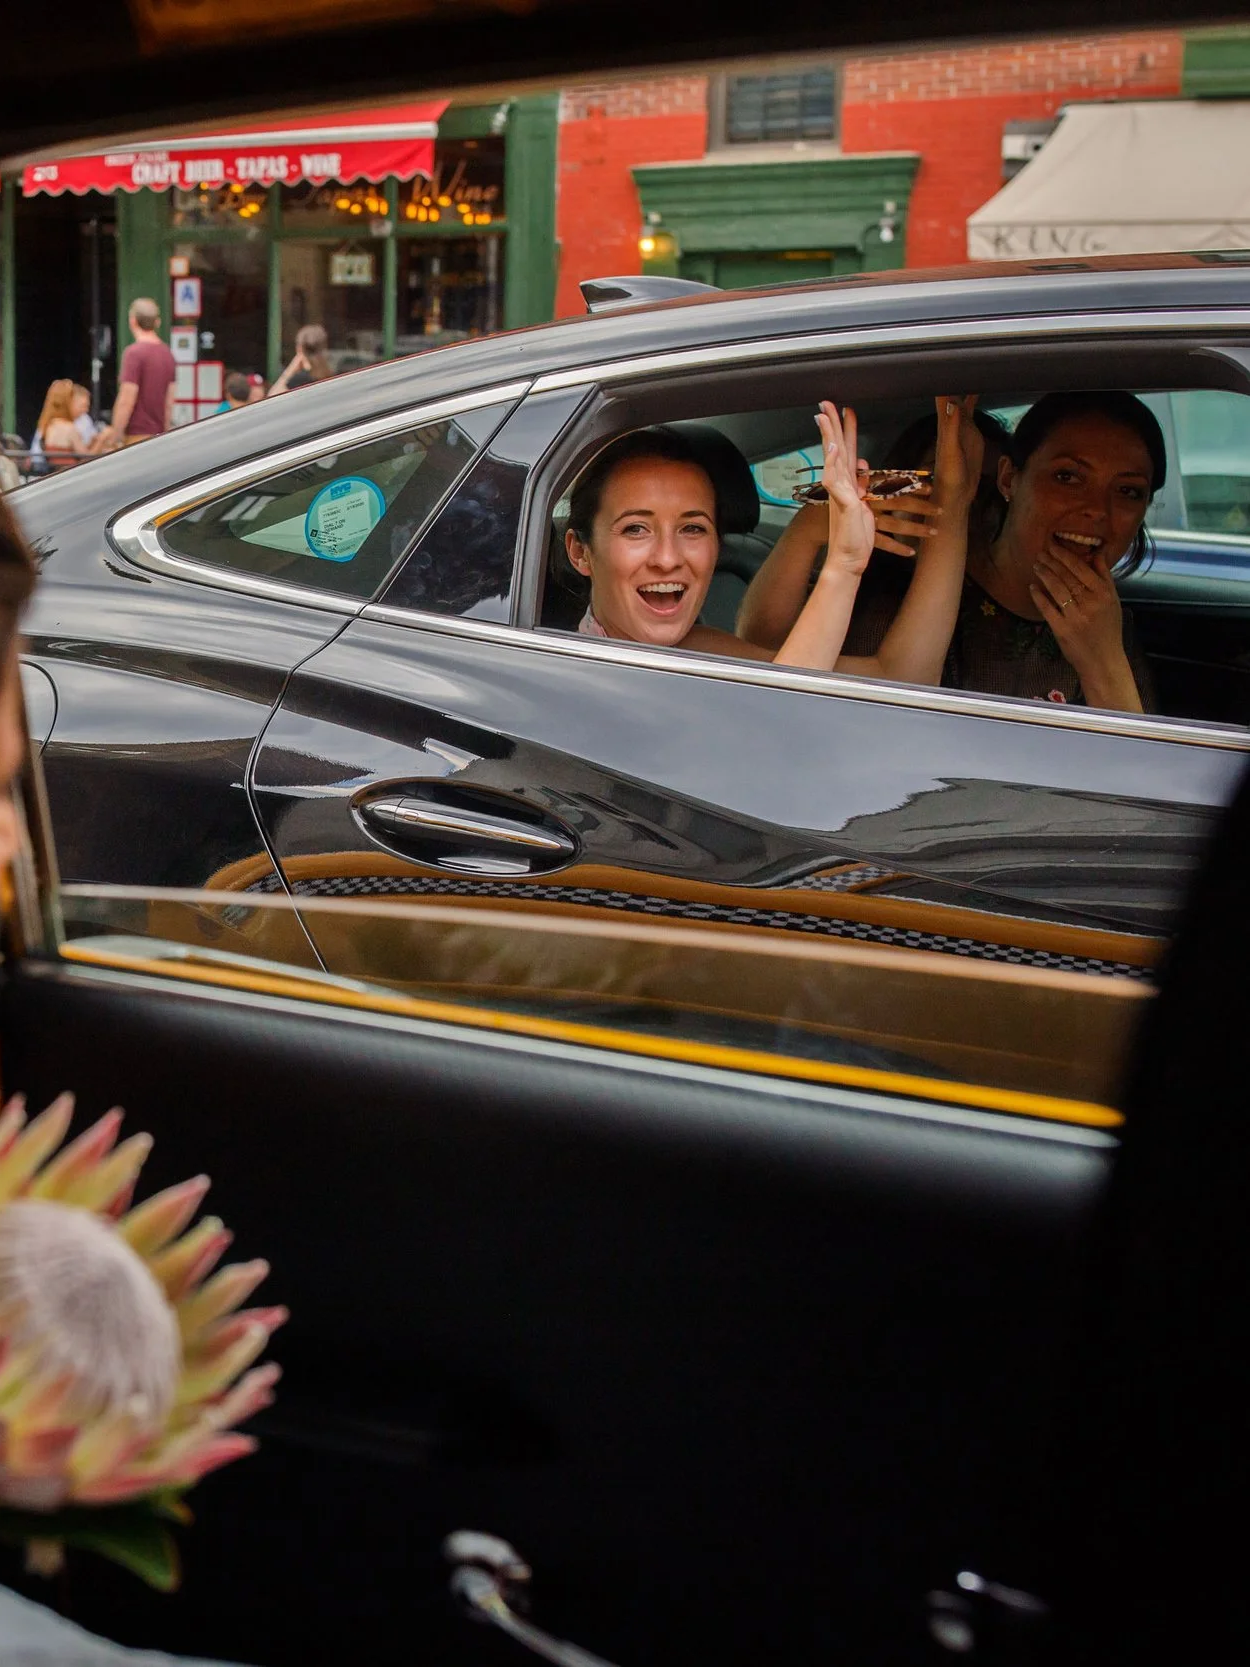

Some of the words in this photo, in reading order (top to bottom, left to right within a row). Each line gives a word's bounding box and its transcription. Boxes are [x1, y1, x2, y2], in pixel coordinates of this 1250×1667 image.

[132, 161, 181, 184] CRAFT
[185, 158, 224, 182] BEER
[235, 155, 288, 180] TAPAS
[300, 153, 341, 177] WINE
[181, 284, 195, 302] A
